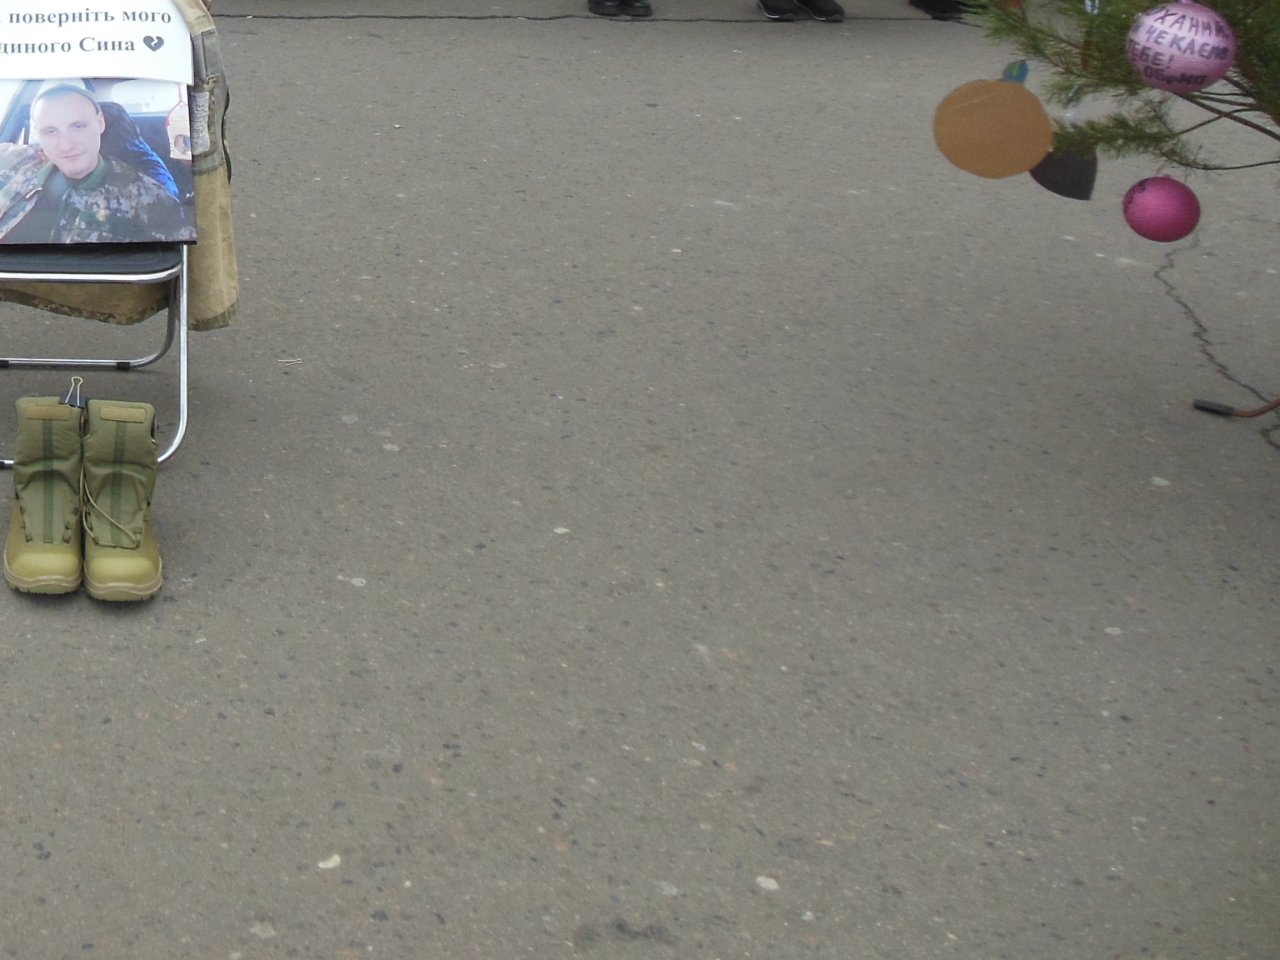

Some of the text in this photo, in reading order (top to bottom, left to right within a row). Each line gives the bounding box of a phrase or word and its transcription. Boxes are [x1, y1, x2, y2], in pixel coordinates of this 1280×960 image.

[8, 8, 115, 28] поверніть
[122, 10, 172, 24] мого
[78, 36, 136, 52] Сина
